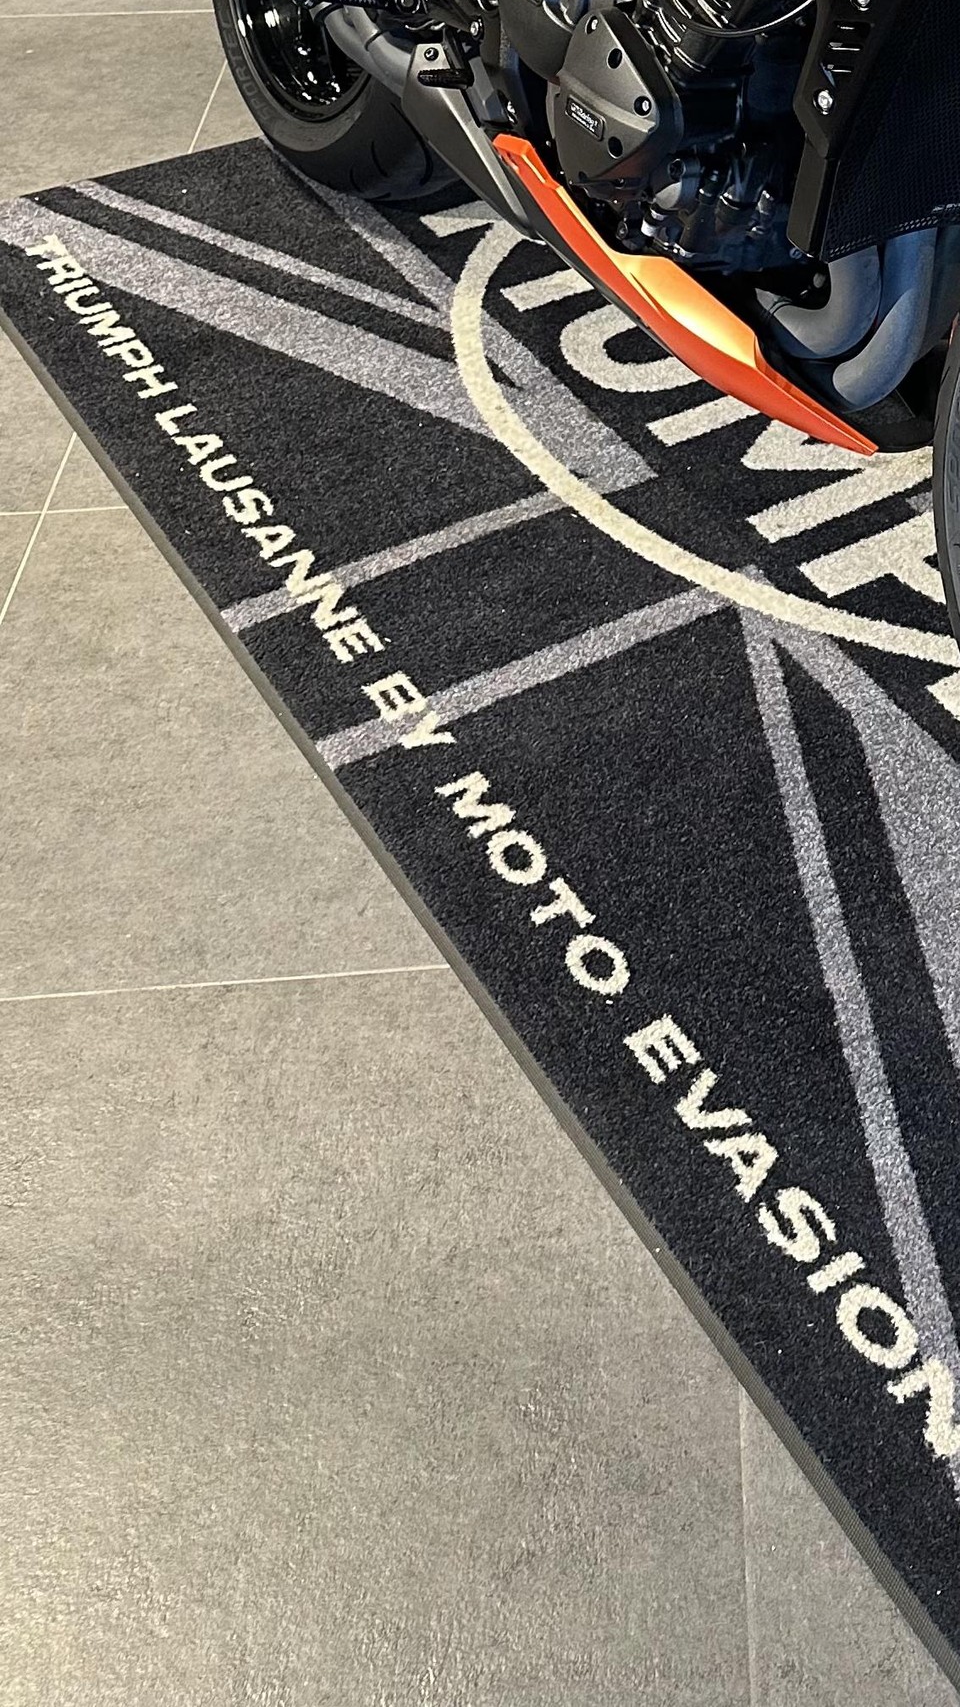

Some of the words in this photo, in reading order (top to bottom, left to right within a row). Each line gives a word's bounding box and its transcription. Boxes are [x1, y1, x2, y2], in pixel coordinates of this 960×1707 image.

[25, 234, 179, 400] TRIUMPH
[155, 402, 384, 665] LAUSANNE
[361, 670, 456, 751] BY
[434, 770, 631, 995] MOTO
